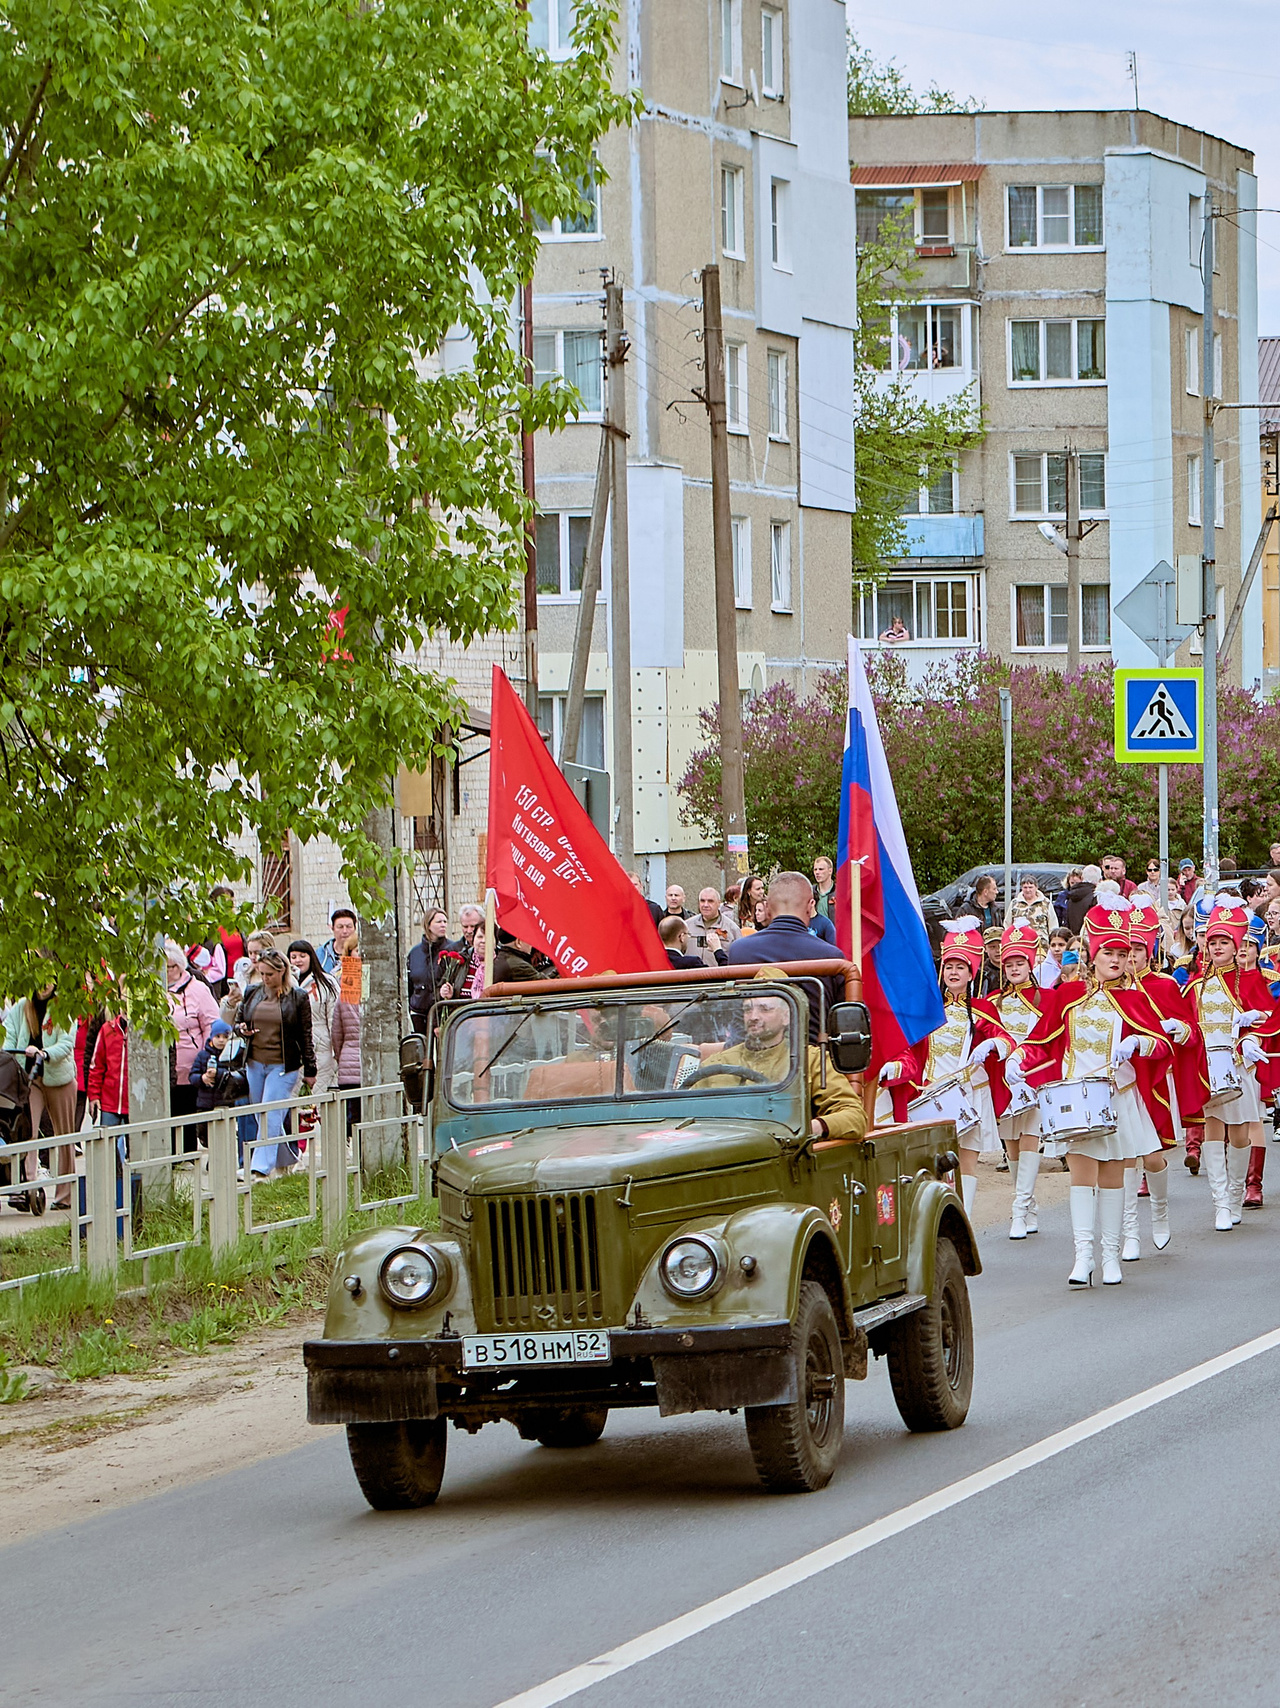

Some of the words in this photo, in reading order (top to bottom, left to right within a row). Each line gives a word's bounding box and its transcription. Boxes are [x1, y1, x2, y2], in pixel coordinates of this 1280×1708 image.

[514, 784, 538, 811] 150
[530, 806, 555, 832] СТР.
[524, 864, 546, 890] ДИВ.
[576, 1333, 600, 1351] 52
